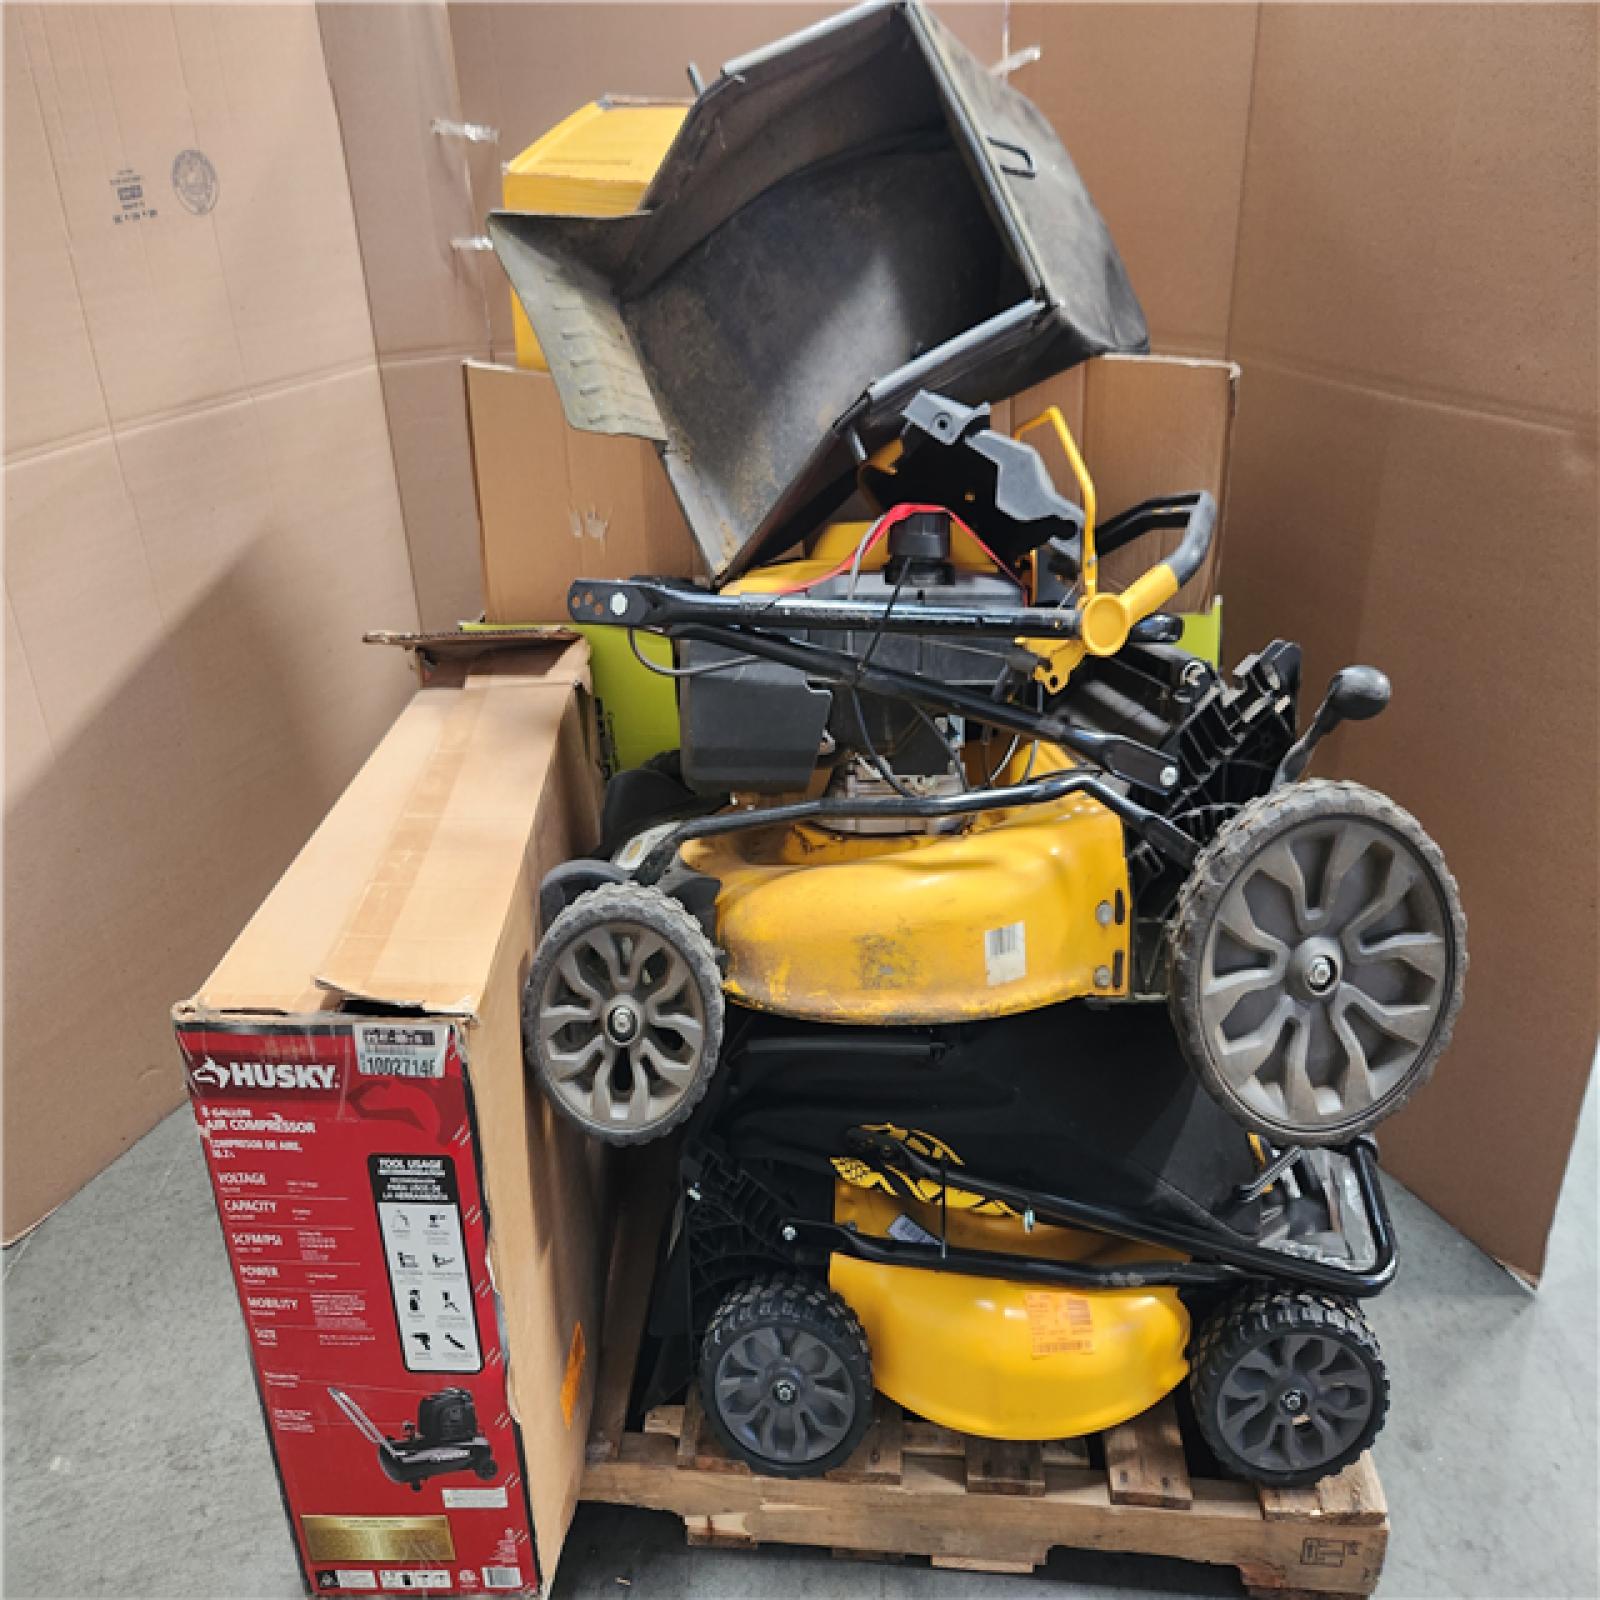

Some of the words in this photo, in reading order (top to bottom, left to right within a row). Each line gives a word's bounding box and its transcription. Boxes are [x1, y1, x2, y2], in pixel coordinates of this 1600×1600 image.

[230, 1063, 336, 1089] HUSKY
[205, 1120, 227, 1131] AIR
[229, 1119, 316, 1133] COMPRESSOR
[378, 1158, 405, 1170] TOOL
[406, 1159, 443, 1171] USAGE
[217, 1172, 267, 1185] VOLTAGE
[224, 1199, 277, 1213] CAPACITY
[239, 1265, 279, 1278] POWER
[247, 1297, 298, 1311] MOBILITY
